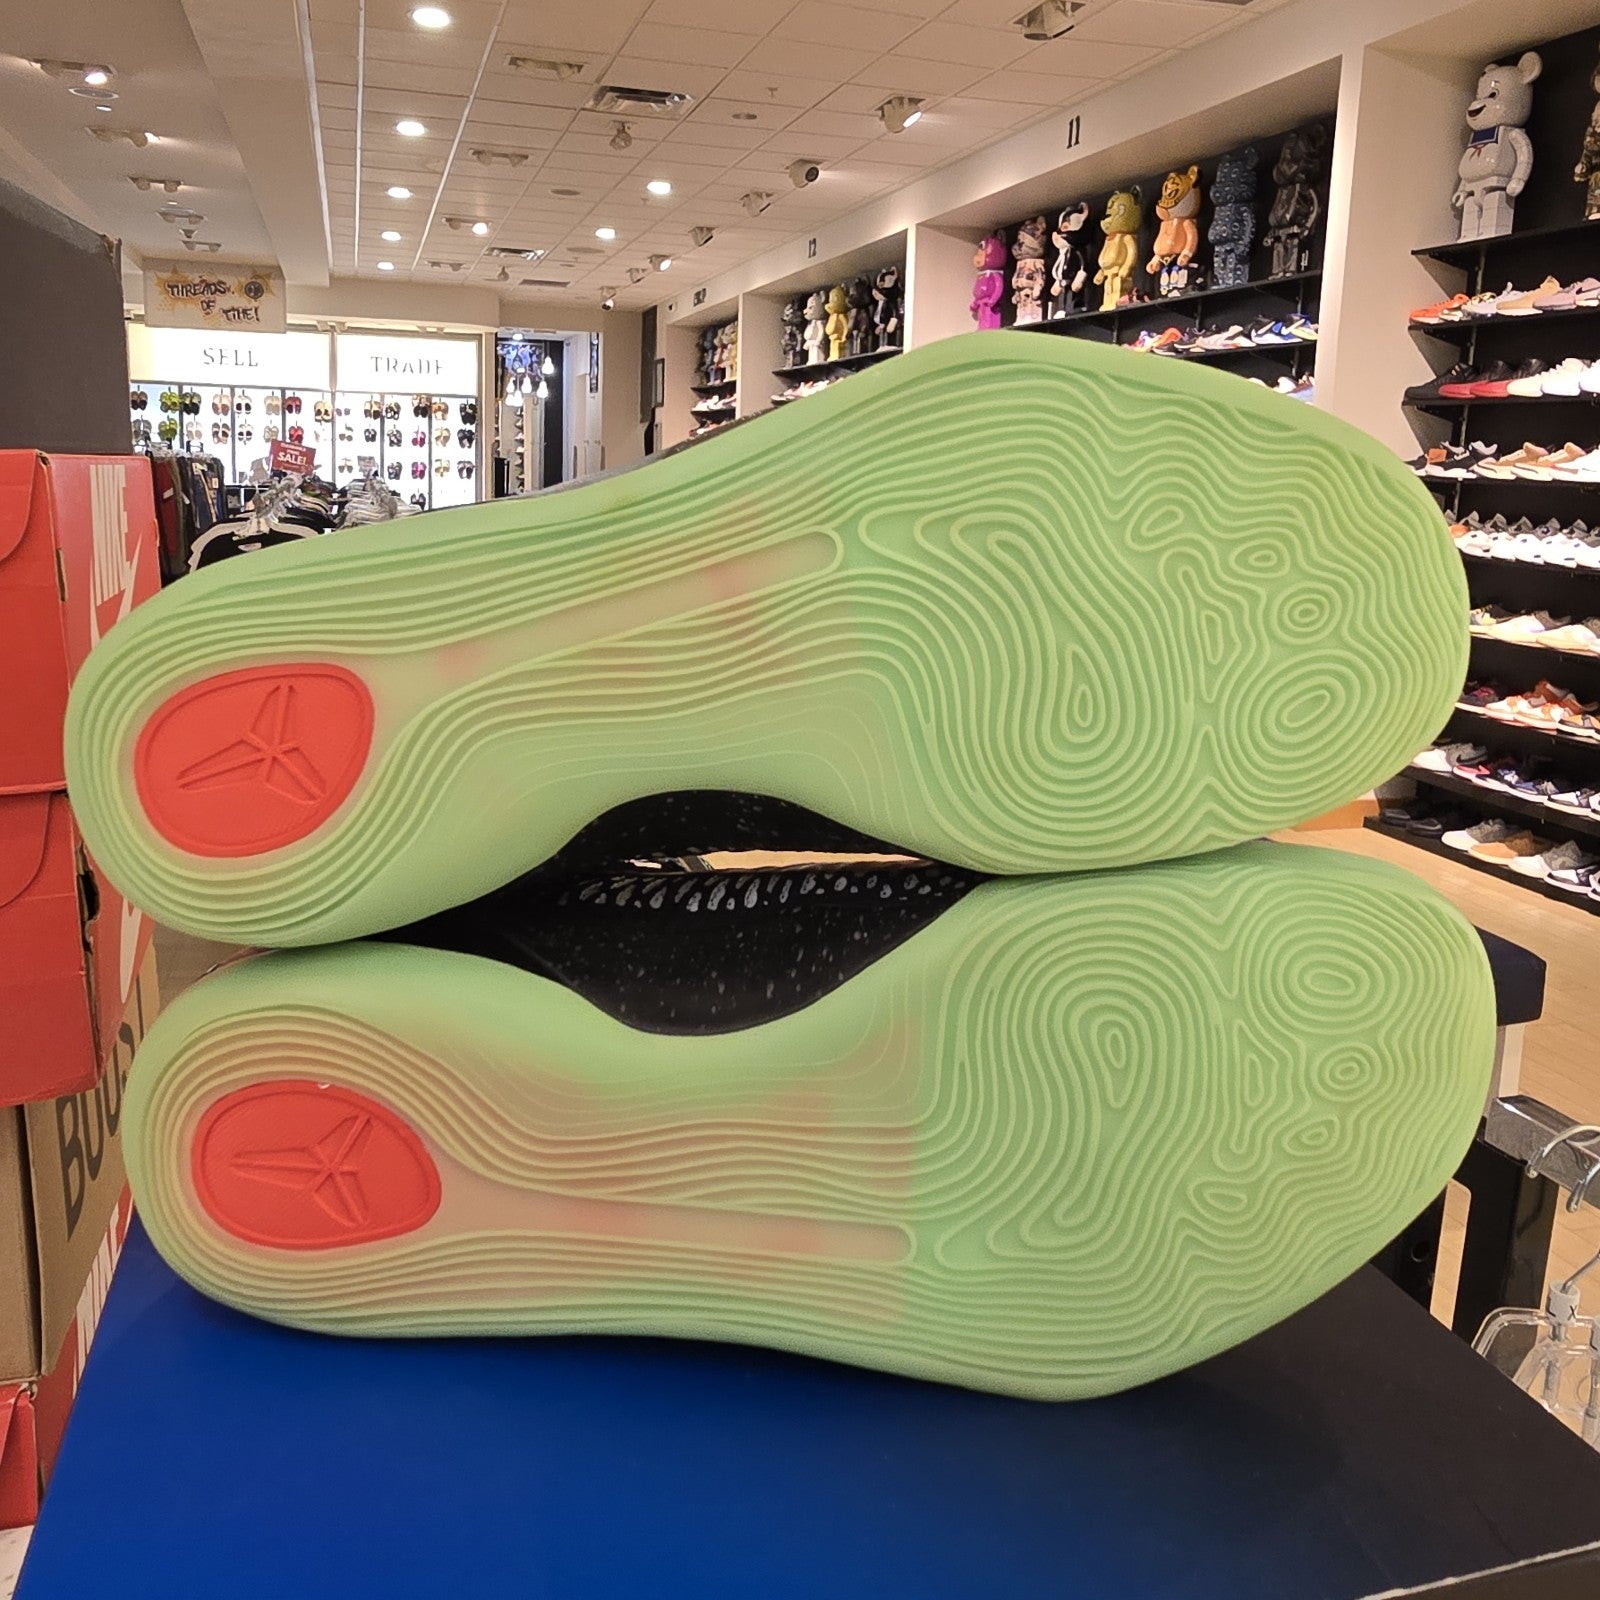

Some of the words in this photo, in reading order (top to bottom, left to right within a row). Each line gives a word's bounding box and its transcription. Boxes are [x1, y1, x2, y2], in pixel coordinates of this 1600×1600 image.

[1066, 115, 1080, 149] 11
[166, 279, 227, 297] THREADS
[203, 347, 259, 367] SELL
[369, 355, 443, 375] TRADE
